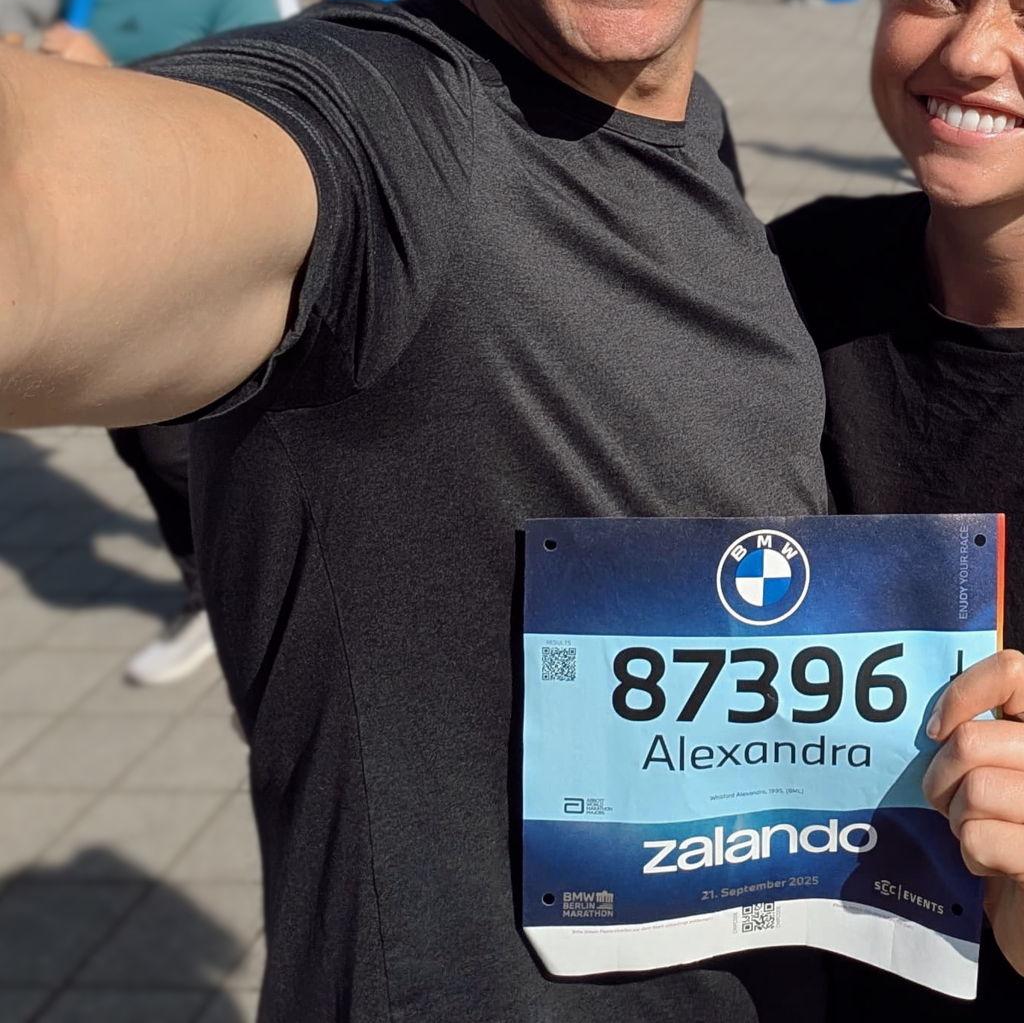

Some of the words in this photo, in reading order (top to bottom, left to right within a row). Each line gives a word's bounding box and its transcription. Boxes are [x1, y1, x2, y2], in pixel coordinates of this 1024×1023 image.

[730, 535, 798, 562] BMW
[959, 525, 969, 555] RACE
[959, 556, 969, 587] YOUR
[959, 588, 969, 620] ENJOY
[611, 643, 908, 724] 87396
[642, 734, 872, 771] Alexandra
[642, 819, 878, 874] zalando
[563, 891, 595, 902] BMW
[701, 890, 718, 901] 21.
[720, 878, 787, 897] September
[789, 876, 820, 887] 2025
[903, 889, 945, 915] EVENTS
[563, 902, 595, 910] BERLIN
